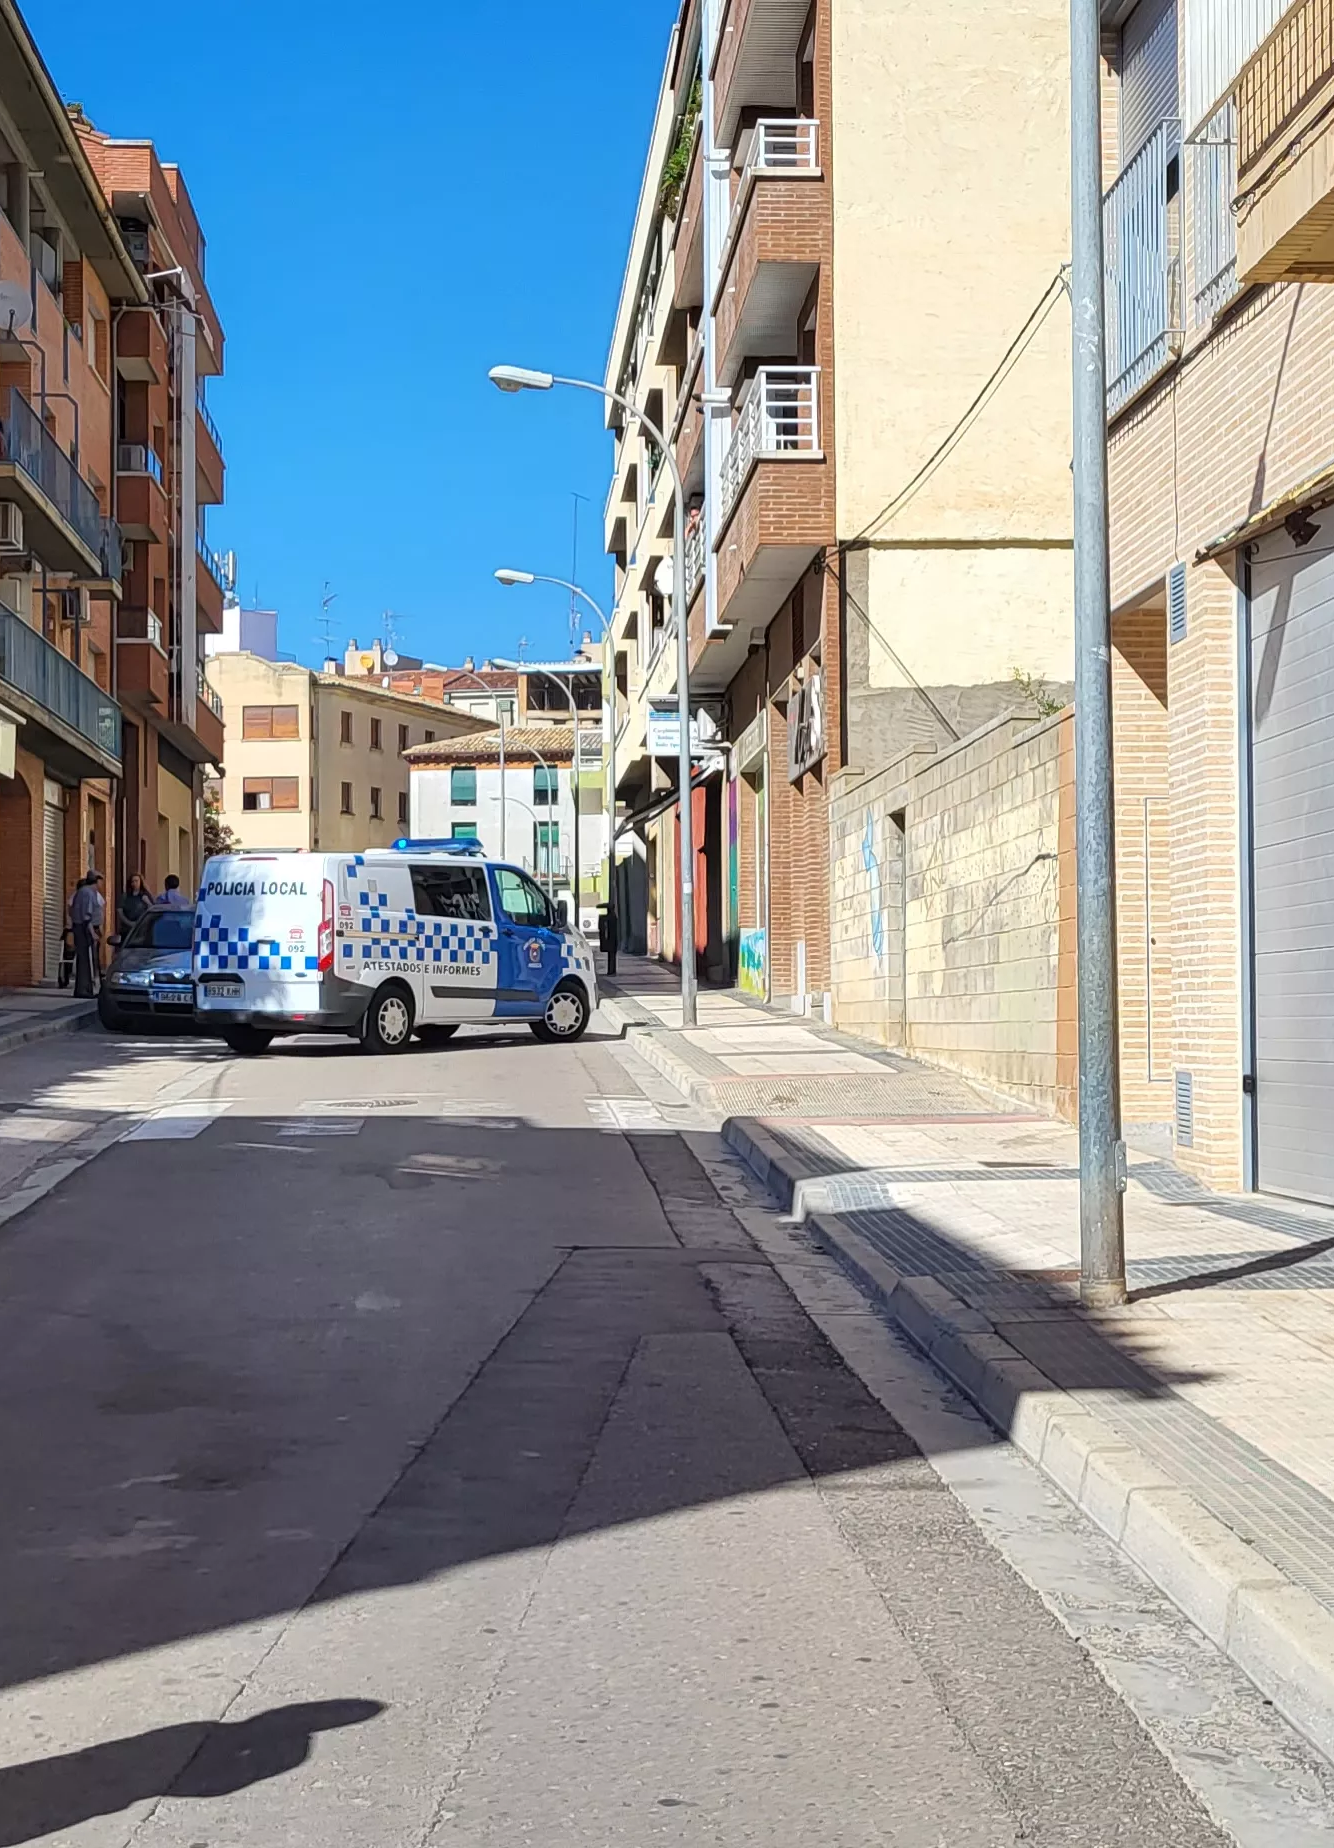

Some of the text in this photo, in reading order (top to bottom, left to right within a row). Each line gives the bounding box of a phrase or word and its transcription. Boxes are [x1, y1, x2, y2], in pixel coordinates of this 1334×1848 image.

[207, 881, 308, 896] POLICIA LOCAL
[339, 921, 354, 930] 092
[287, 944, 306, 953] 092
[363, 961, 481, 977] ATESTADOS E INFORMES
